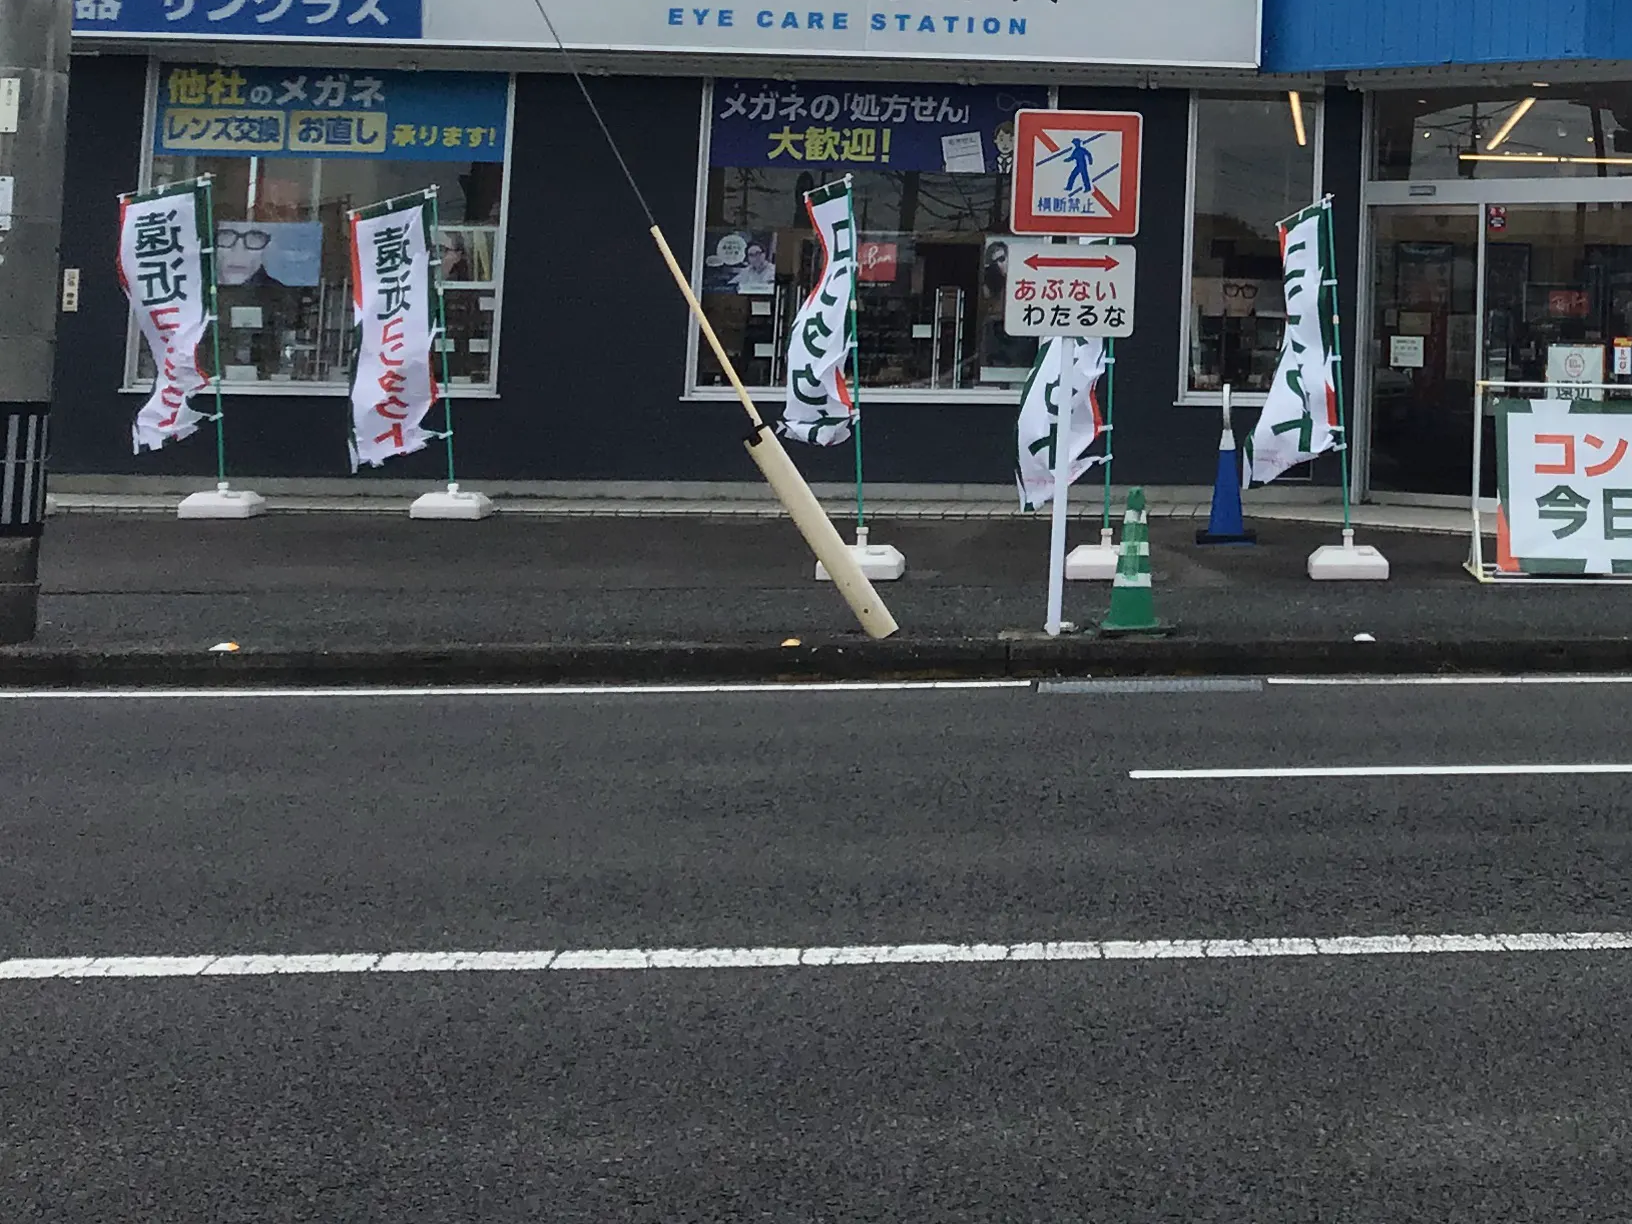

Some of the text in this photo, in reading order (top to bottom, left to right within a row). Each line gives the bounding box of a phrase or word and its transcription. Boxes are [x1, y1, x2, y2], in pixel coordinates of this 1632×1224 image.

[668, 8, 1027, 35] EYE CARE STATION
[168, 69, 384, 107] 他社のメガネ
[720, 92, 971, 124] メガネの「処方せん」
[168, 115, 280, 144] レンズ交換
[297, 115, 379, 145] お直し
[1037, 197, 1095, 214] 横断禁止
[1014, 279, 1117, 301] あぶない
[1022, 304, 1126, 327] わたるな
